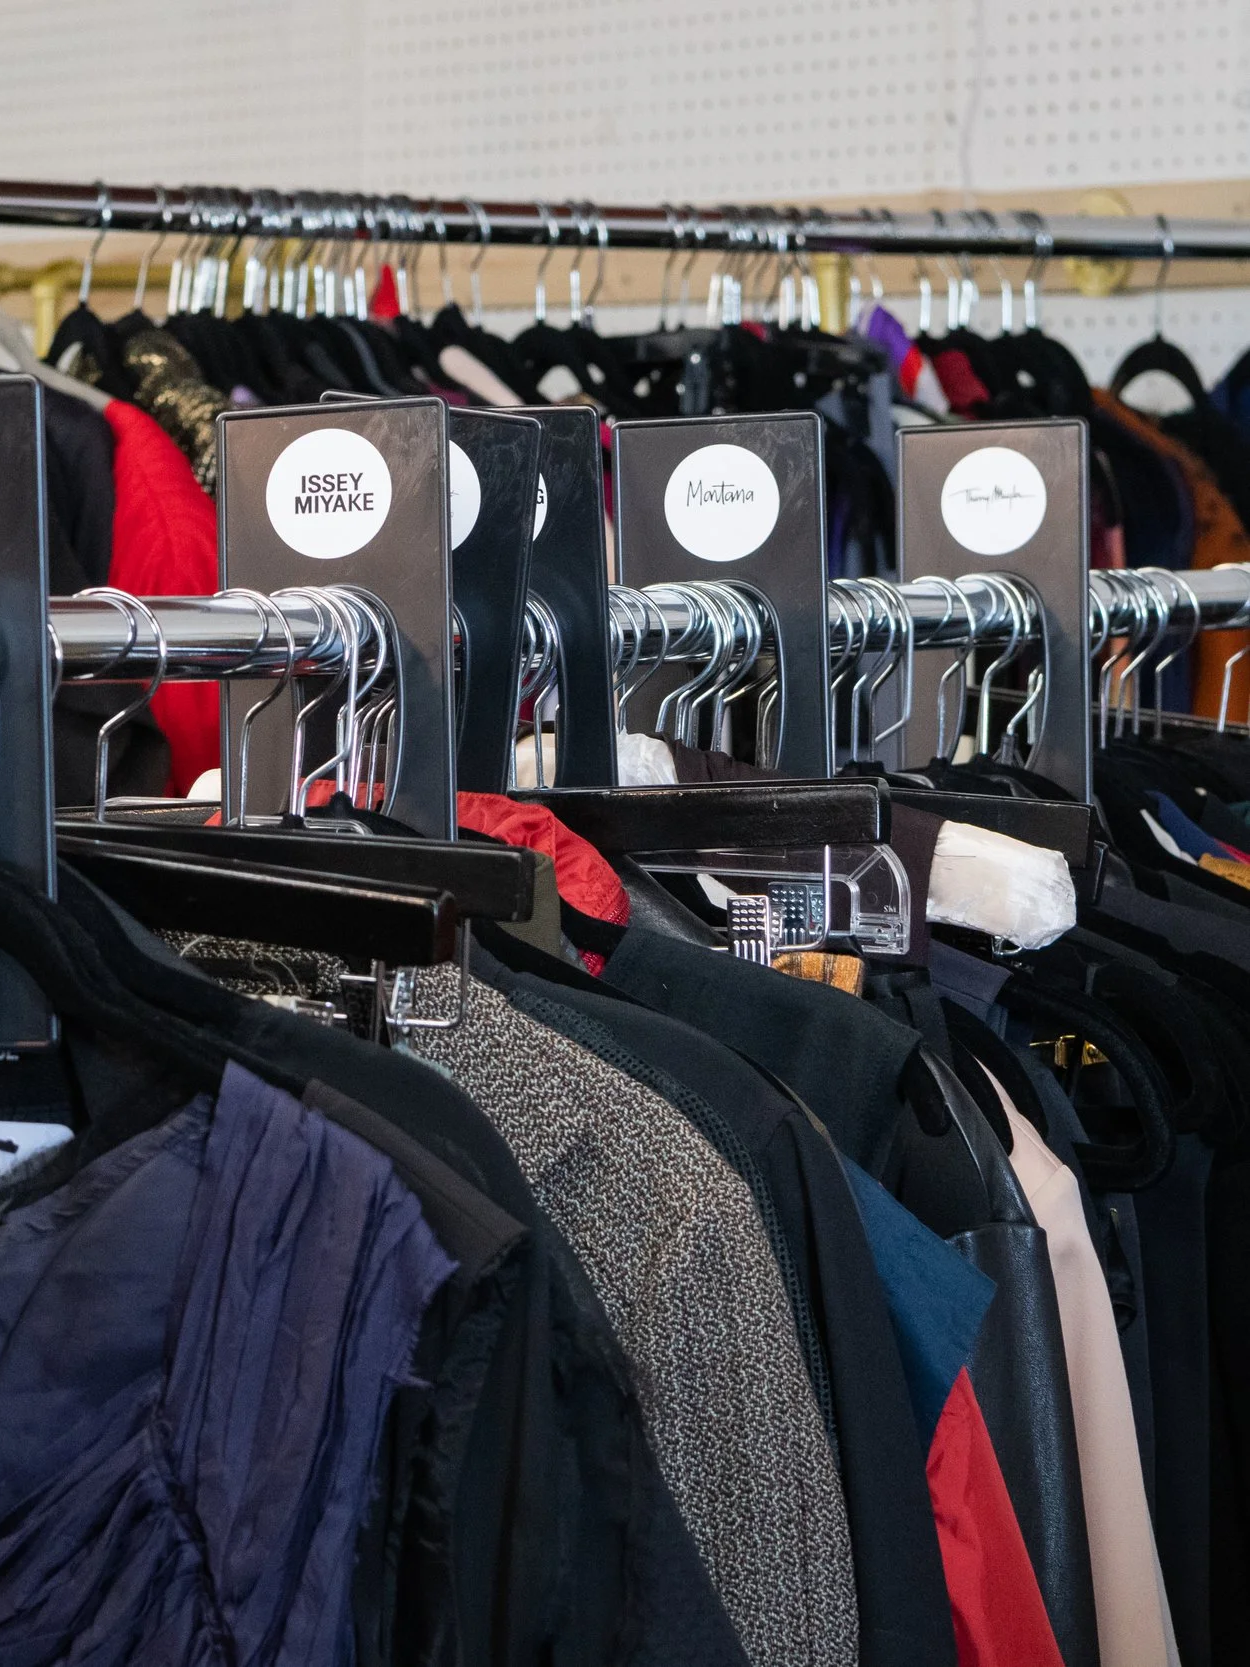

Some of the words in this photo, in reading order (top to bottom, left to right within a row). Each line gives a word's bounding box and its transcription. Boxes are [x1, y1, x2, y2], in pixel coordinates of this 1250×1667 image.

[301, 472, 363, 494] ISSEY
[686, 480, 754, 507] Montana
[294, 492, 374, 514] MIYAKE
